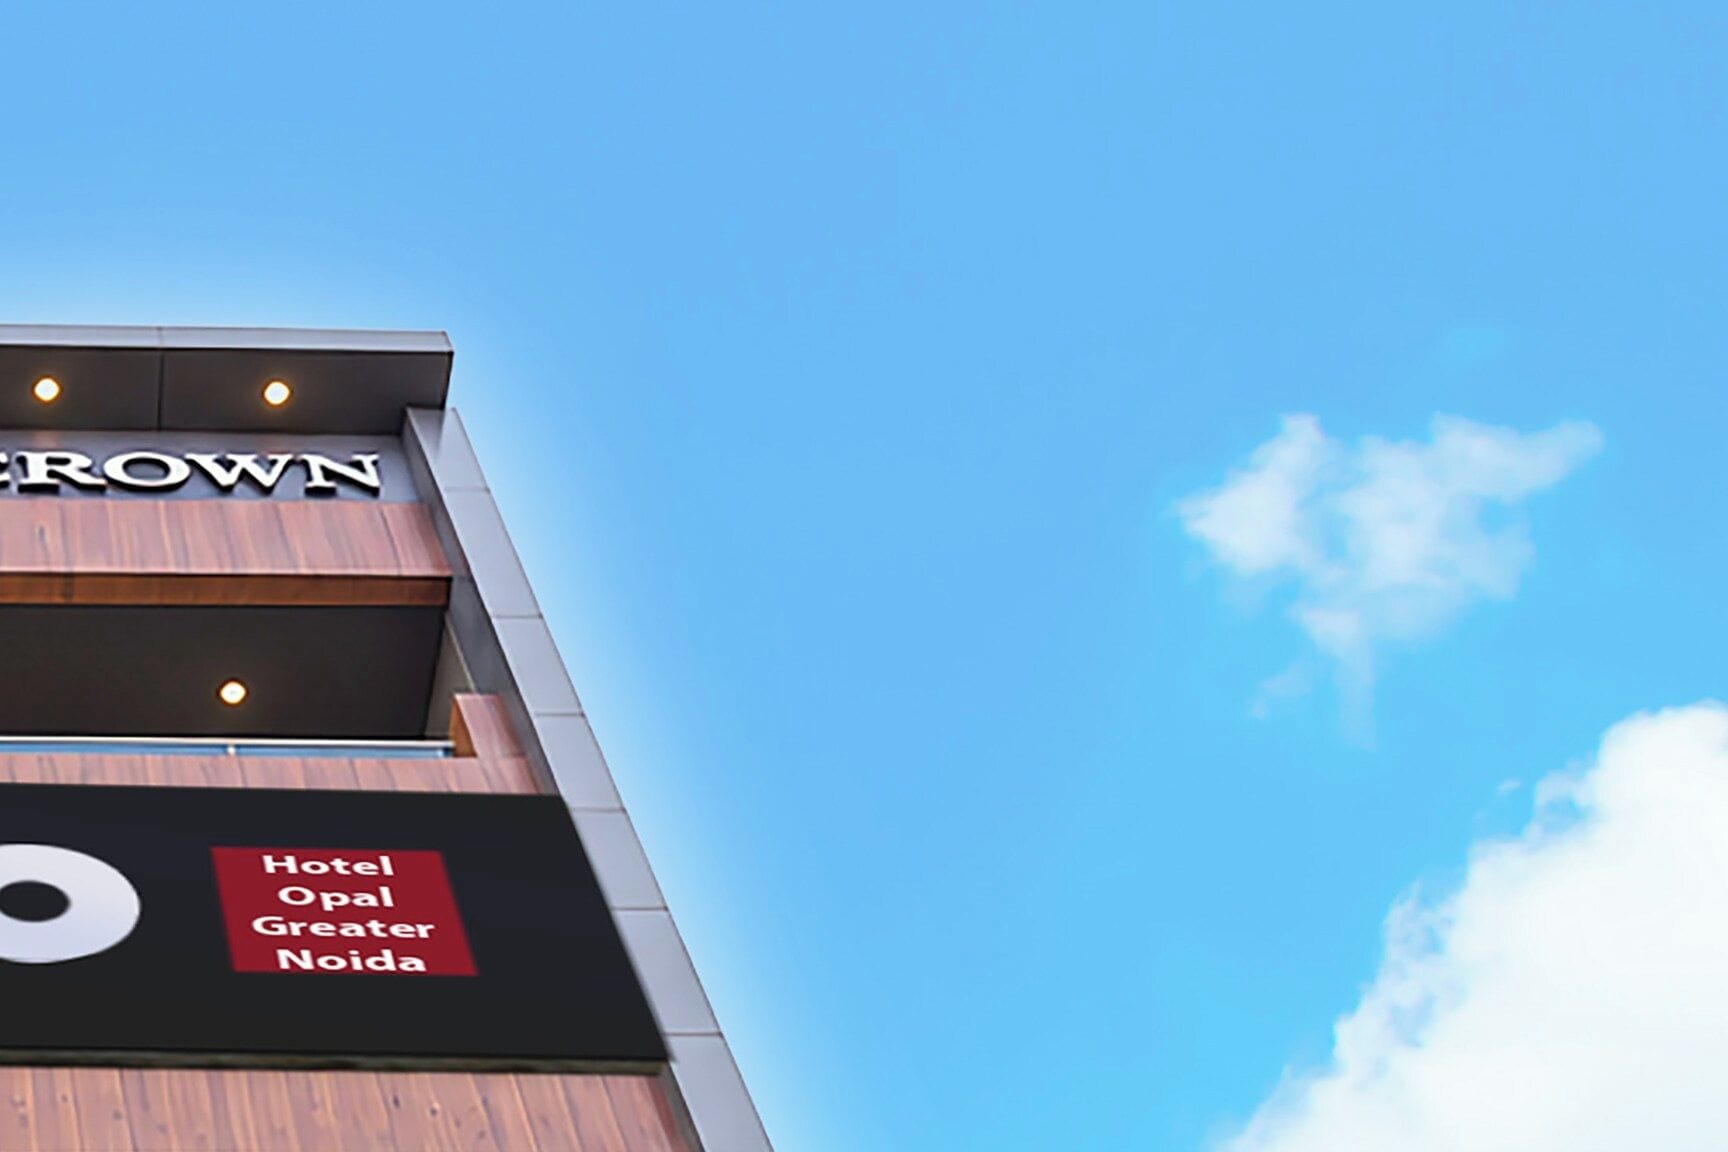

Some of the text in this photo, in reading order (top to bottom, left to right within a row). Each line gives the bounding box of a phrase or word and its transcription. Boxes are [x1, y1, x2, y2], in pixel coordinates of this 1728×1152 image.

[262, 854, 394, 876] Hotel
[277, 886, 394, 912] Opal
[252, 915, 435, 939] Greater
[276, 948, 427, 972] Noida
